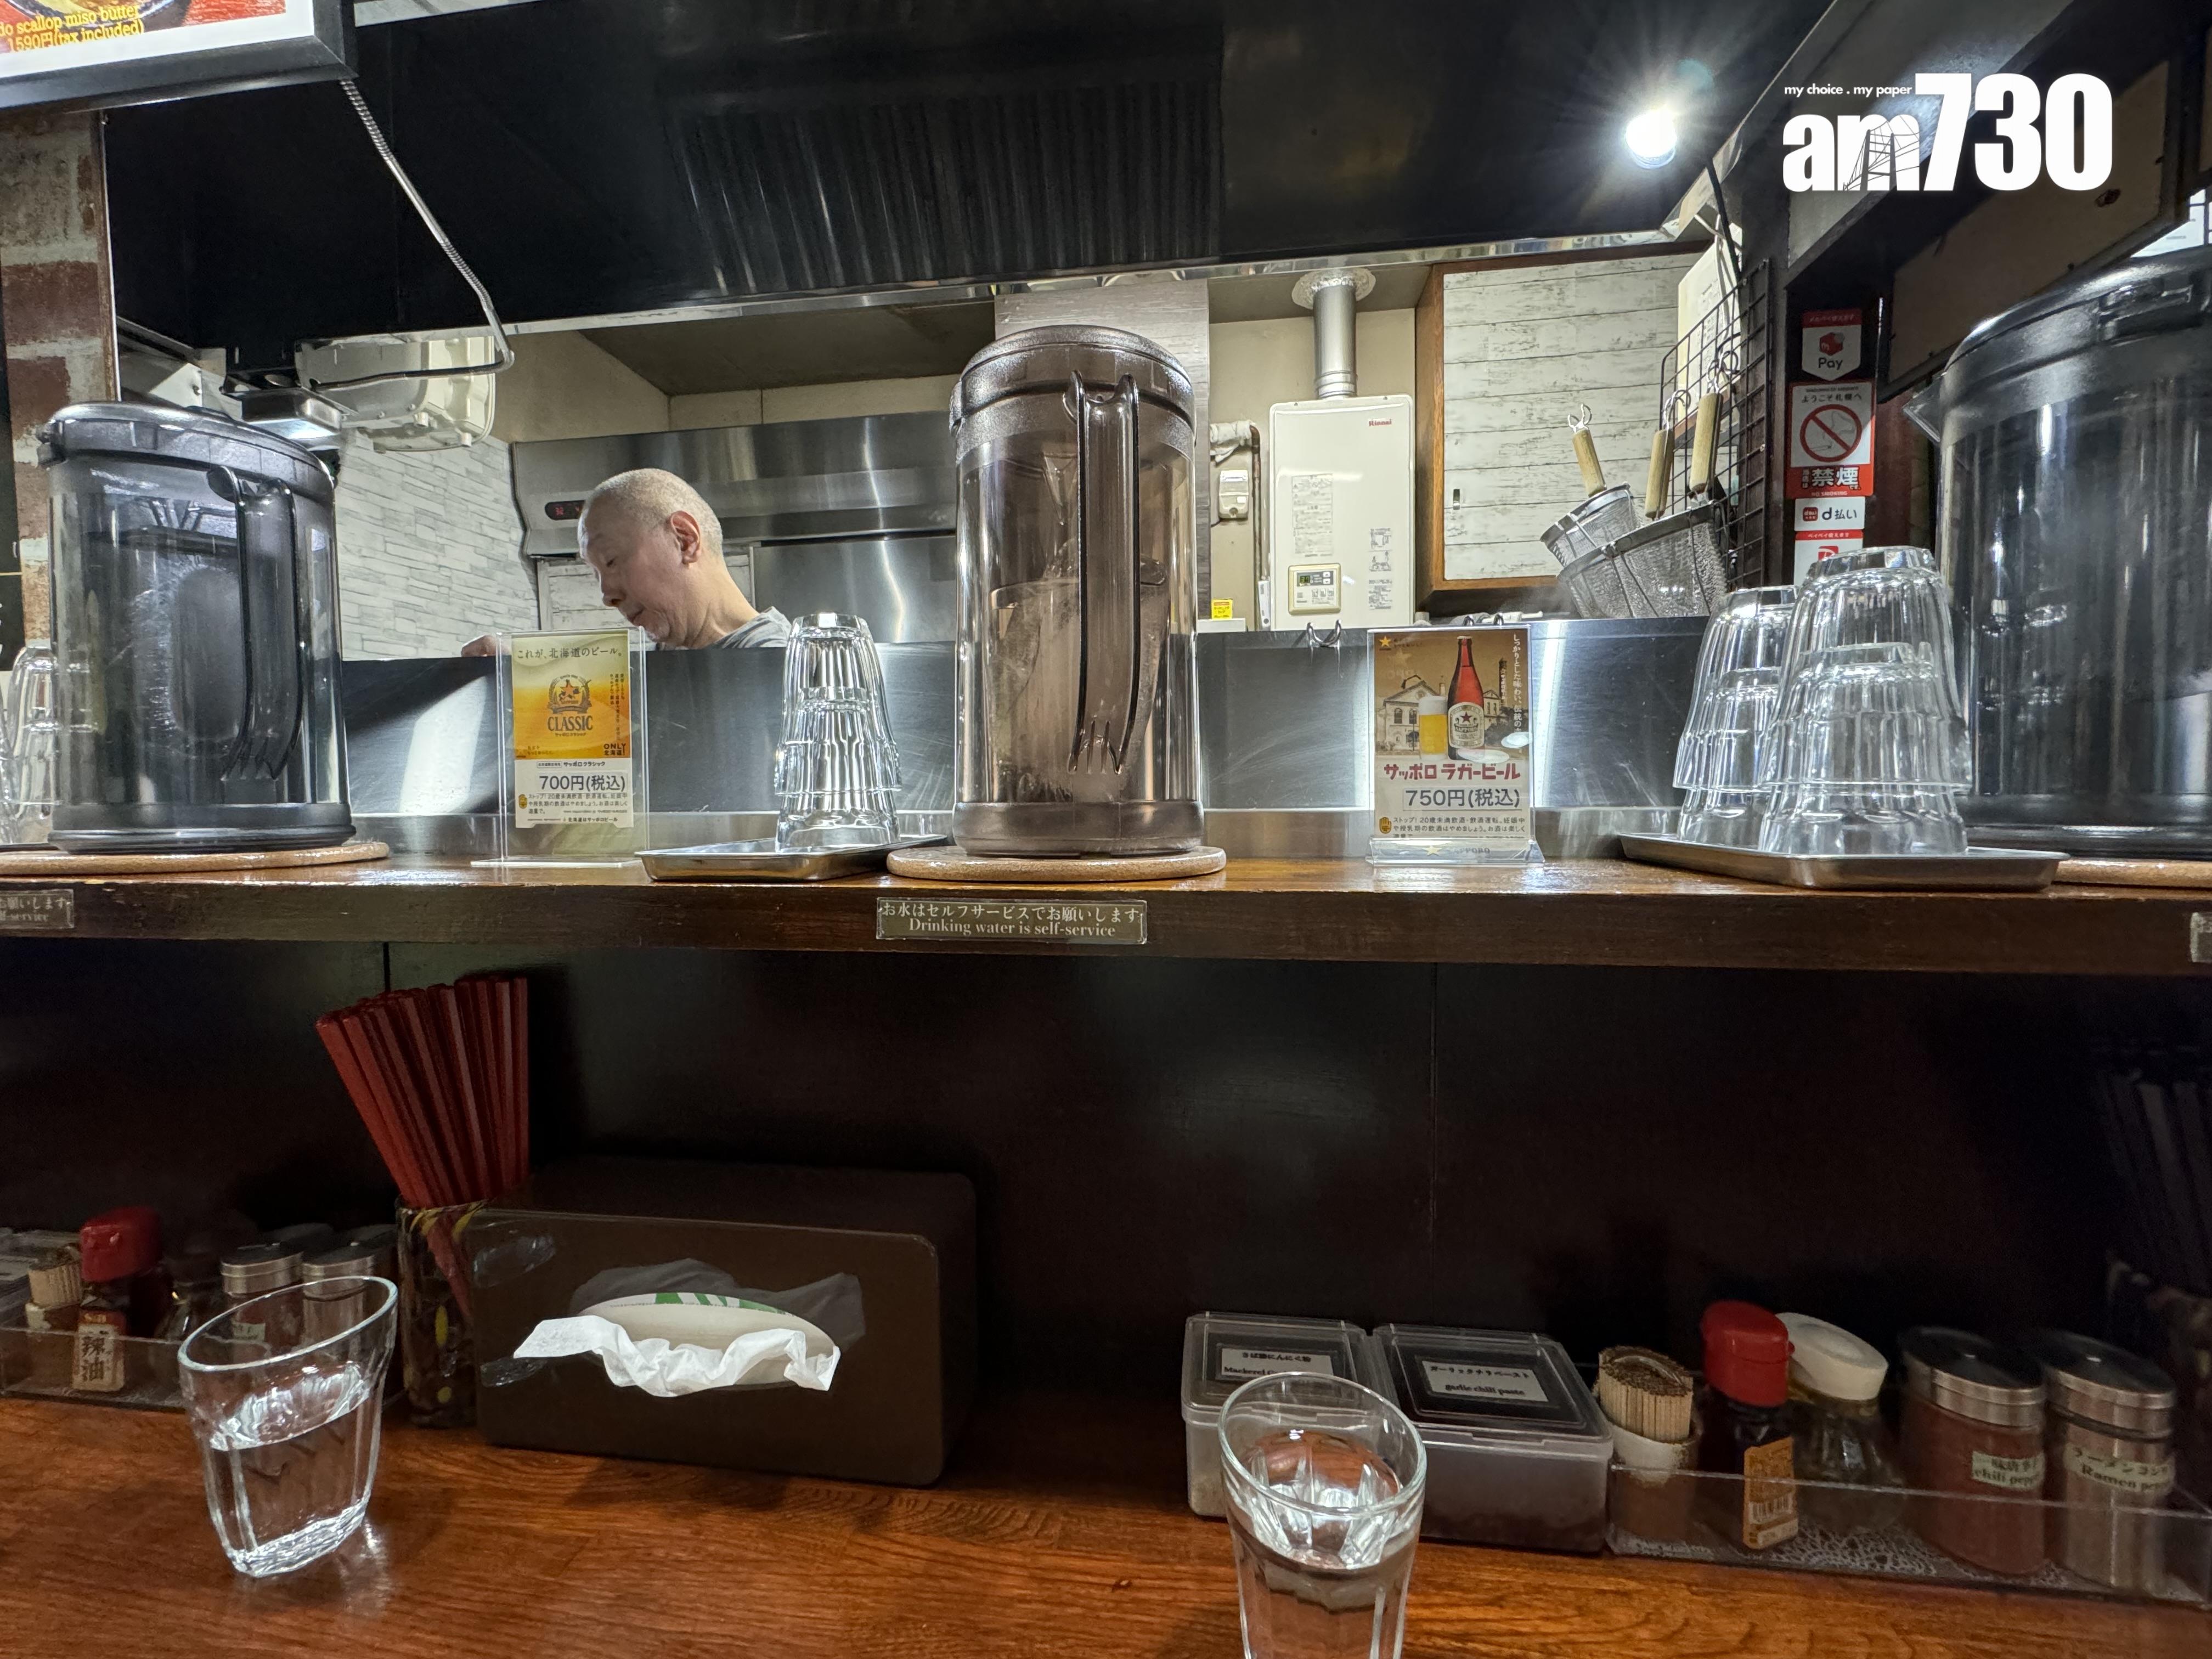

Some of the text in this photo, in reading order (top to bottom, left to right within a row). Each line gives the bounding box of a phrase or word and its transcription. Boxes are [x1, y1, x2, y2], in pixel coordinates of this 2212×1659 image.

[16, 13, 62, 33] scallop
[65, 12, 97, 27] miso
[99, 5, 140, 21] butter
[81, 18, 144, 41] included)
[1818, 357, 1843, 370] Pay
[1812, 467, 1860, 487] 禁煙
[1822, 507, 1857, 520] d払い
[517, 647, 622, 658] これが、北海道のビール。
[548, 715, 593, 731] CLASSIC
[1384, 763, 1521, 780] サッポロ ラガービール
[539, 775, 625, 792] 700円(税込)
[1406, 788, 1520, 808] 750円(税込)
[882, 902, 1139, 923] お水はセルフサービスでお願いします
[909, 918, 1115, 936] Drinking water is self-service
[2081, 1463, 2137, 1488] Ramen
